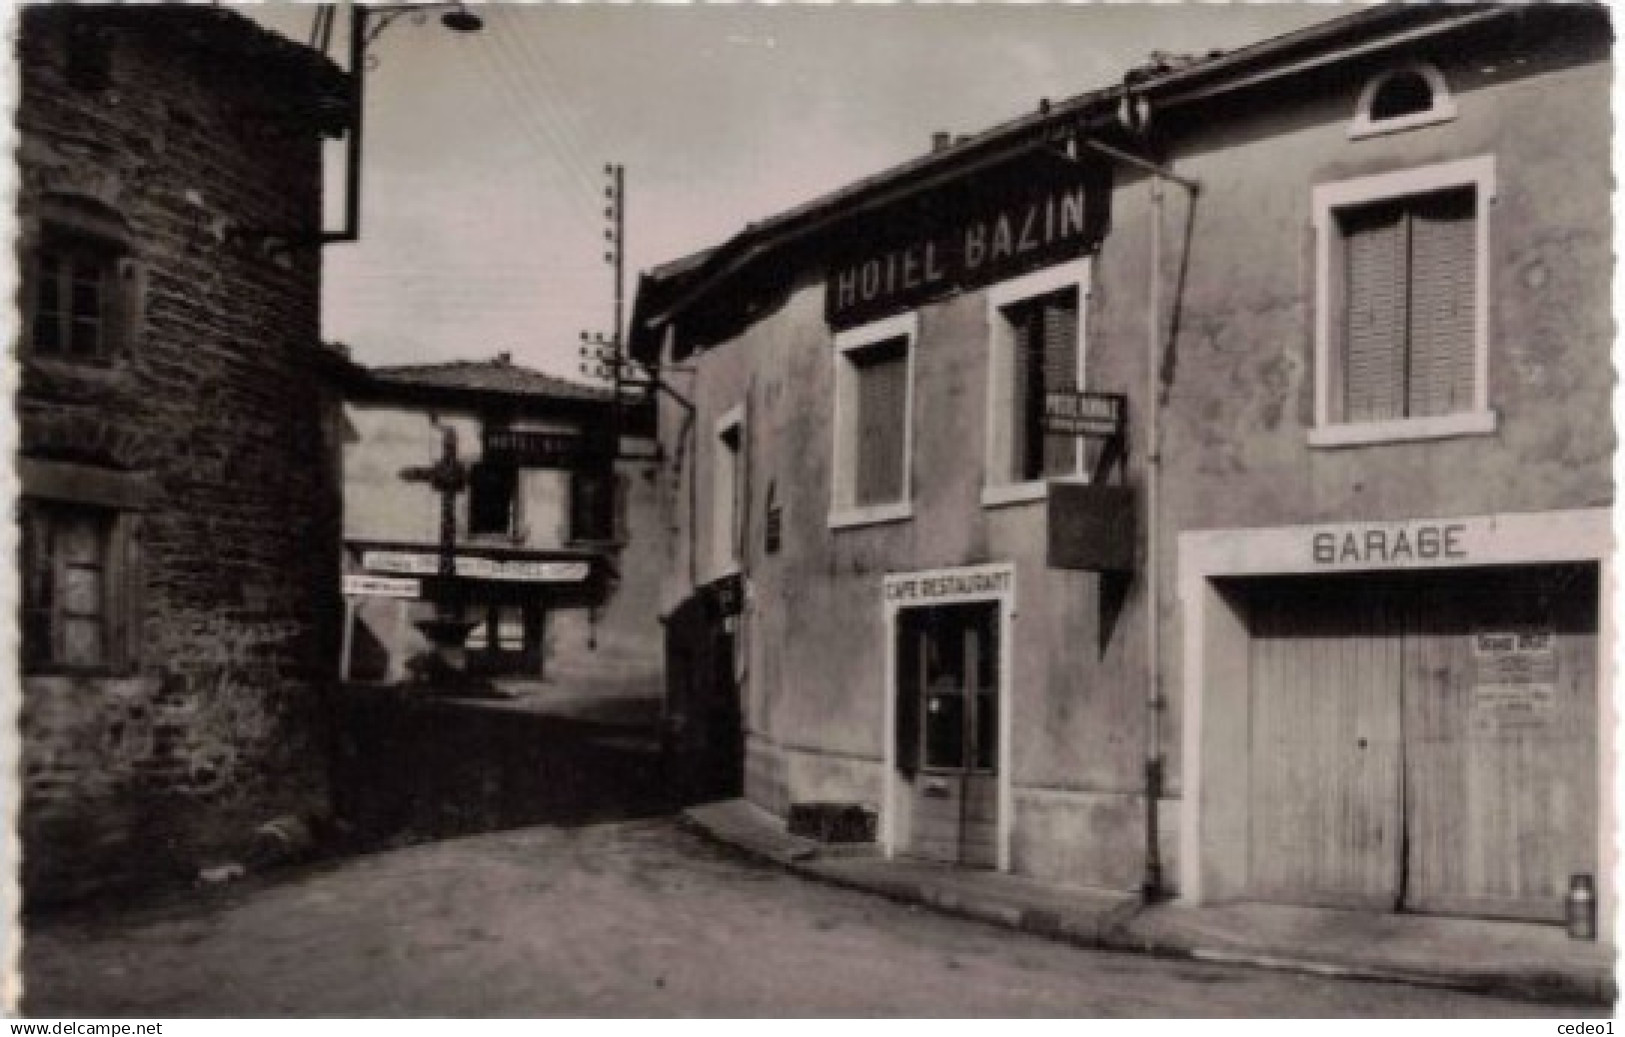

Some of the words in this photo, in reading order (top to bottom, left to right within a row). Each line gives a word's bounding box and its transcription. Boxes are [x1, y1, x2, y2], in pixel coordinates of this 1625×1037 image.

[838, 241, 943, 310] HOTEL
[964, 186, 1085, 269] BAZIN
[1312, 524, 1468, 564] GARAGE
[921, 572, 1011, 597] RESTAURANT
